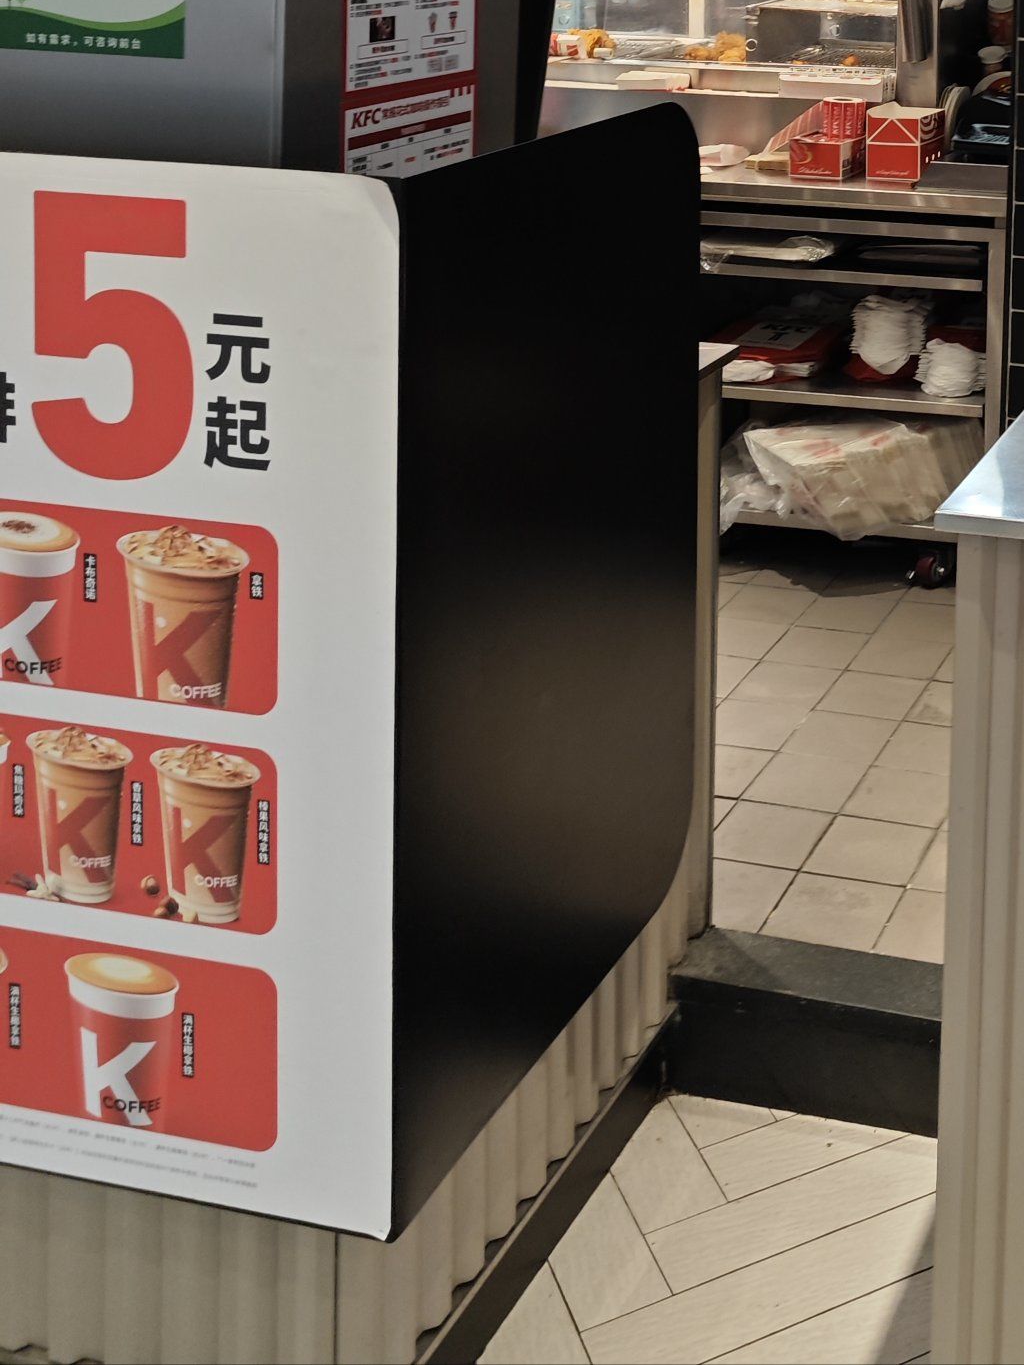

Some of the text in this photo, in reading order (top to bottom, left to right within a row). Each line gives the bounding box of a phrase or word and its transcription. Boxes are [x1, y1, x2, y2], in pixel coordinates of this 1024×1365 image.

[351, 107, 381, 129] KFC
[31, 190, 194, 480] 5
[204, 313, 271, 472] 元起
[84, 555, 97, 600] 卡布奇诺
[251, 574, 263, 598] 拿铁
[4, 657, 63, 675] COFFEE
[143, 601, 223, 707] K
[170, 682, 223, 699] COFFEE
[48, 788, 113, 884] K
[132, 782, 143, 845] 香草风味拿铁
[258, 800, 270, 864] 榛果风味拿铁
[70, 855, 112, 868] COFFEE
[173, 806, 239, 904] K
[194, 874, 238, 889] COFFEE
[80, 1026, 157, 1127] K
[102, 1095, 162, 1113] COFFEE
